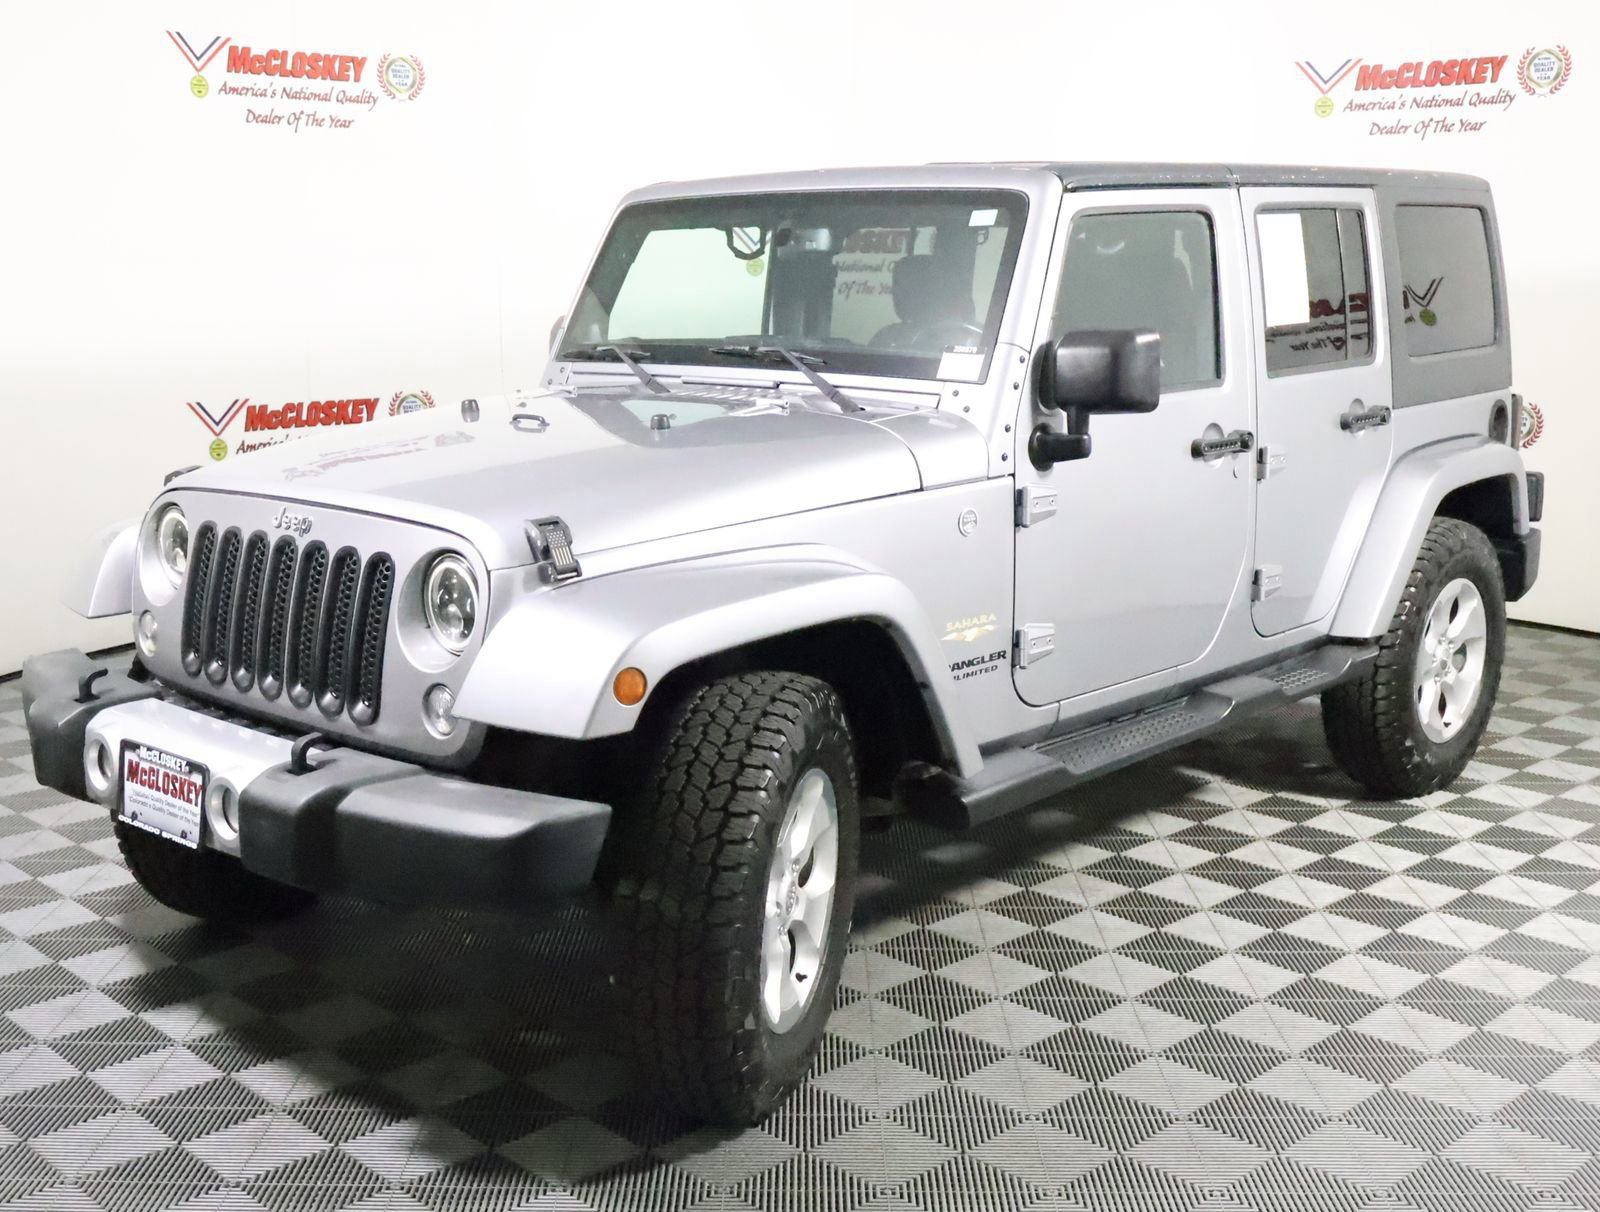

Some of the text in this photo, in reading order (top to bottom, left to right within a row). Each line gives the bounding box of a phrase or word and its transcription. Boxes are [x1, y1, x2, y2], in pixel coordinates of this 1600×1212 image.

[227, 45, 367, 83] McCLOSKEY
[1354, 55, 1508, 92] McCLOSKEY
[218, 81, 277, 99] America's
[280, 86, 333, 103] National
[336, 89, 379, 112] Quality
[1342, 93, 1407, 113] America's
[1409, 90, 1468, 110] National
[1468, 87, 1516, 112] Quality
[245, 108, 355, 133] Dealer Of The Year
[1369, 116, 1487, 141] Dealer Of The Year
[244, 397, 380, 432] McCLOSKEY
[272, 505, 313, 537] Jeep
[945, 613, 997, 632] SAHARA
[949, 650, 1007, 672] ANGLER
[953, 664, 999, 681] LIMITED
[139, 745, 187, 773] McCLOSKEY
[126, 759, 202, 807] McCLOSKEY
[118, 814, 160, 836] COLORADO
